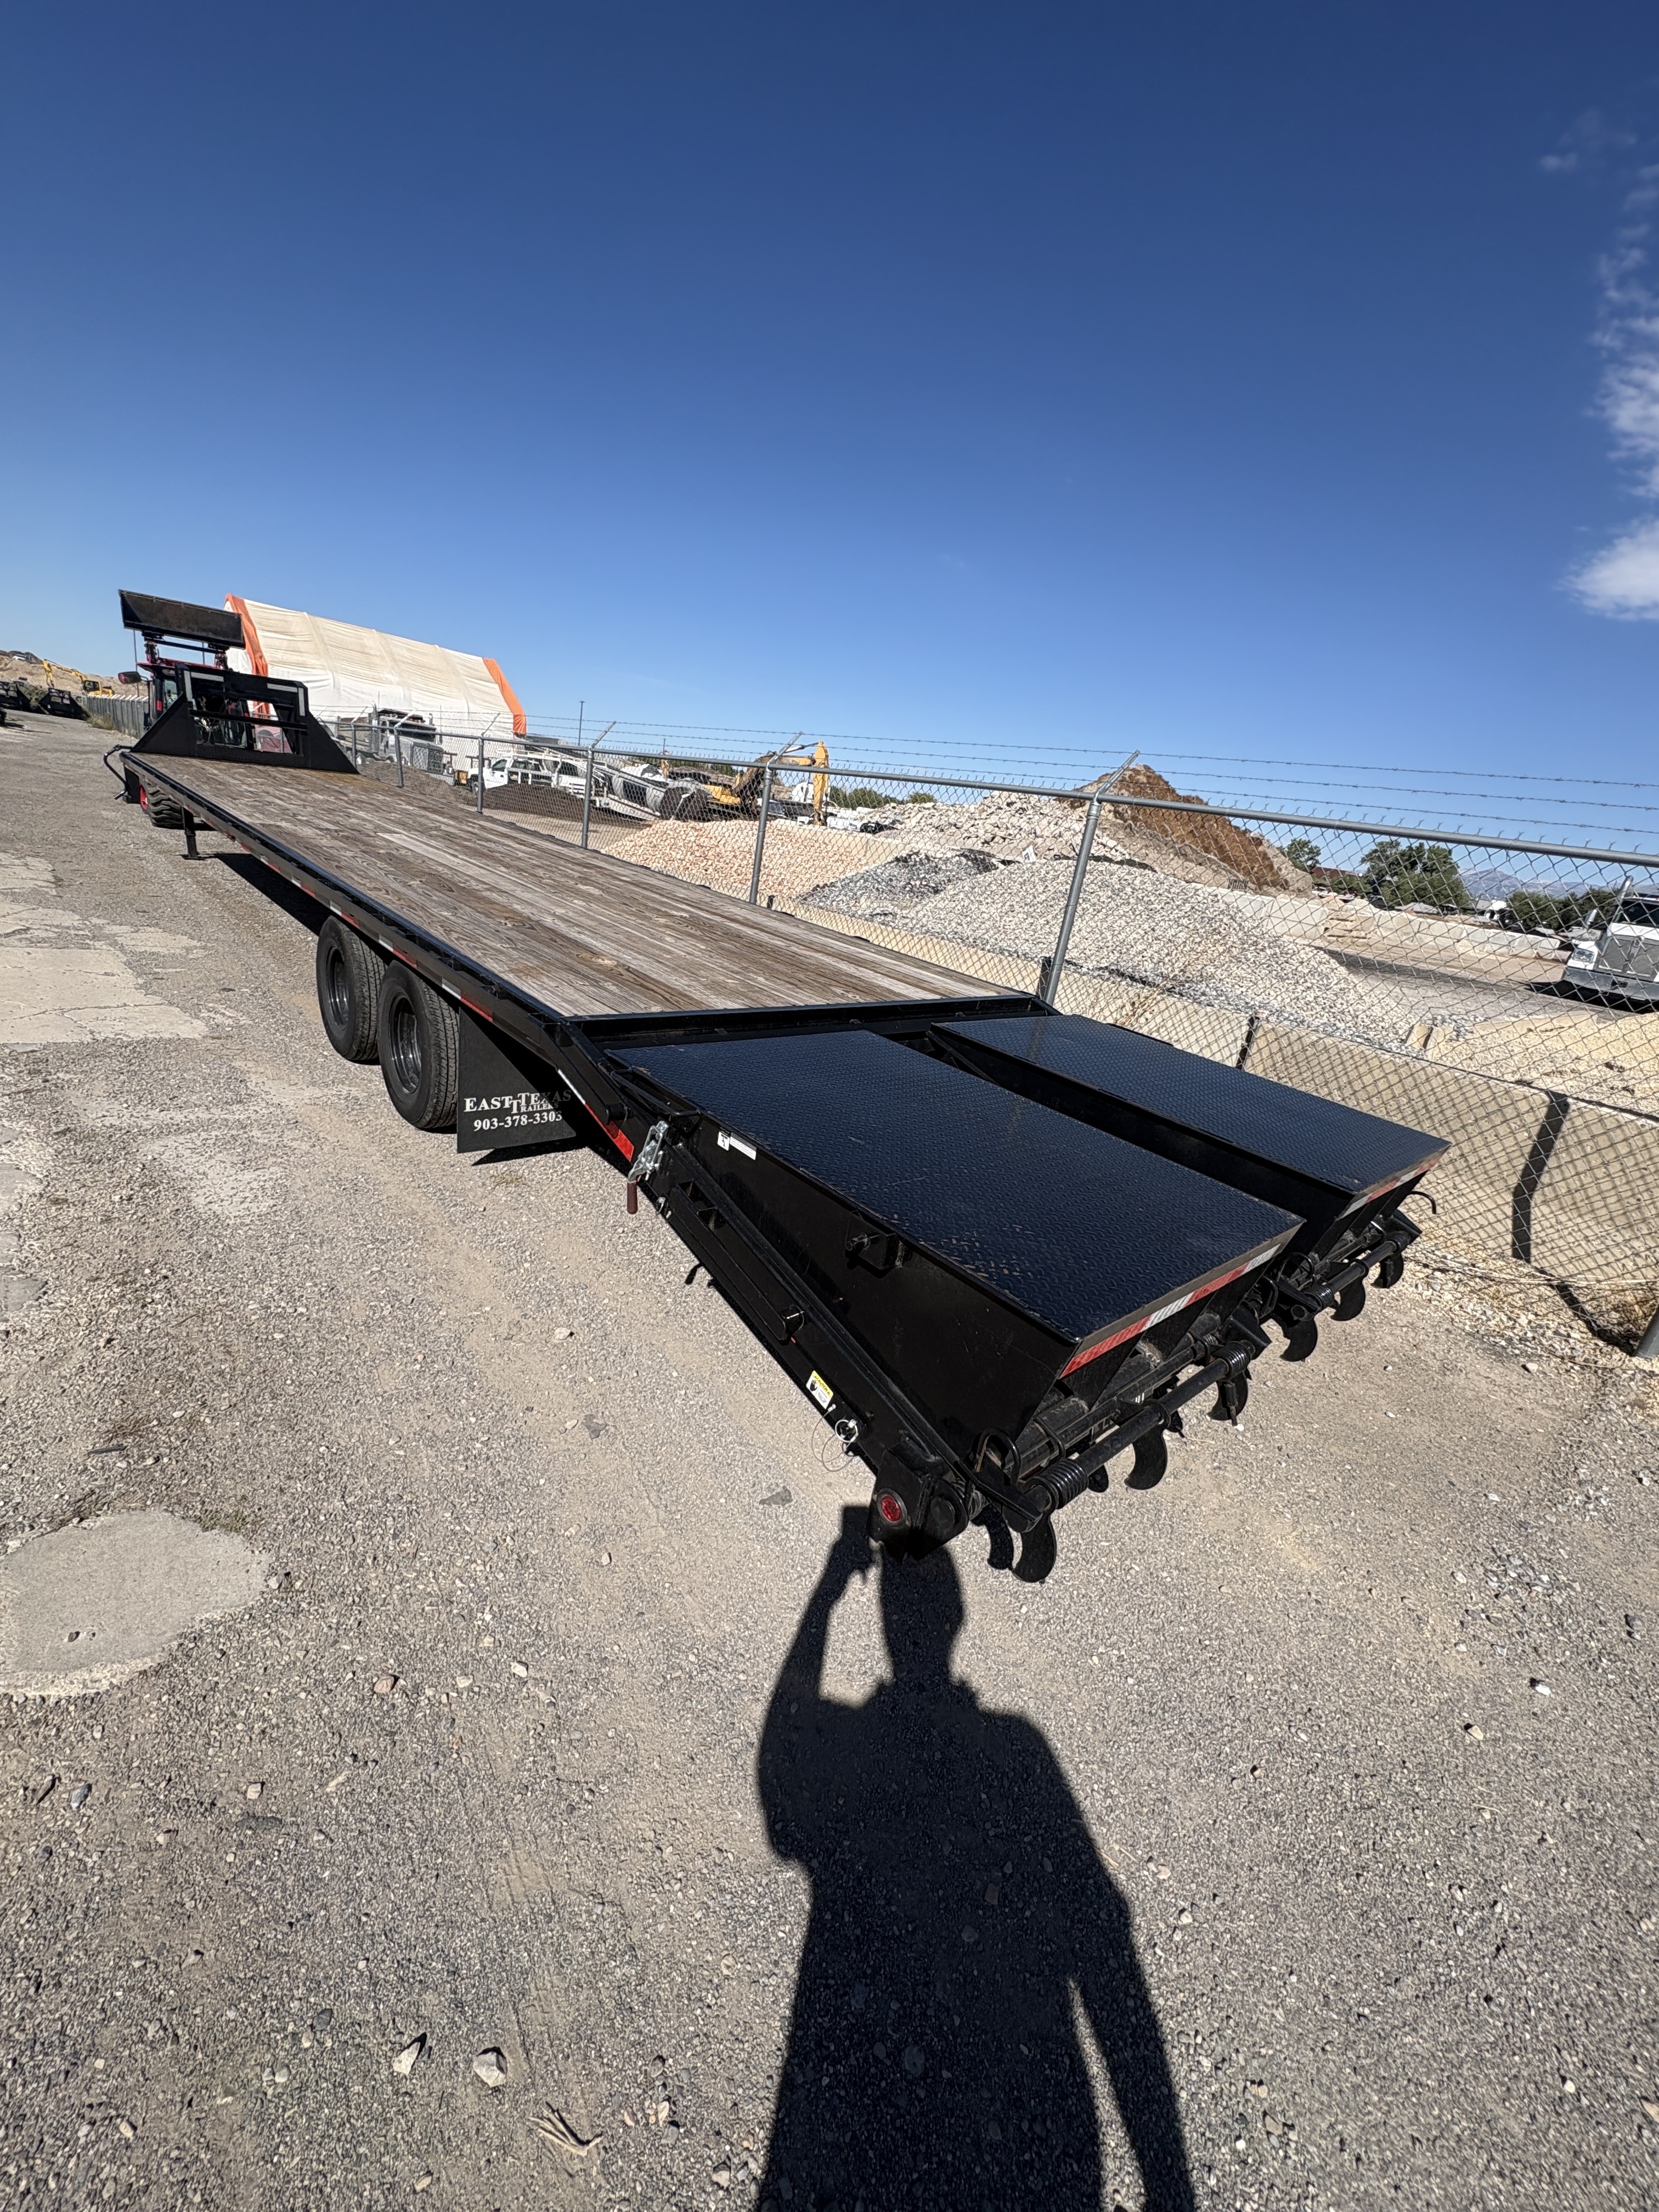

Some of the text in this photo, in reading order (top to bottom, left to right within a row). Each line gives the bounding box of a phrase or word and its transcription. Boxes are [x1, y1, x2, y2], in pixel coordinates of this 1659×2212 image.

[464, 1090, 571, 1112] EAST TEXAS
[473, 1110, 563, 1131] 903-378-3303
